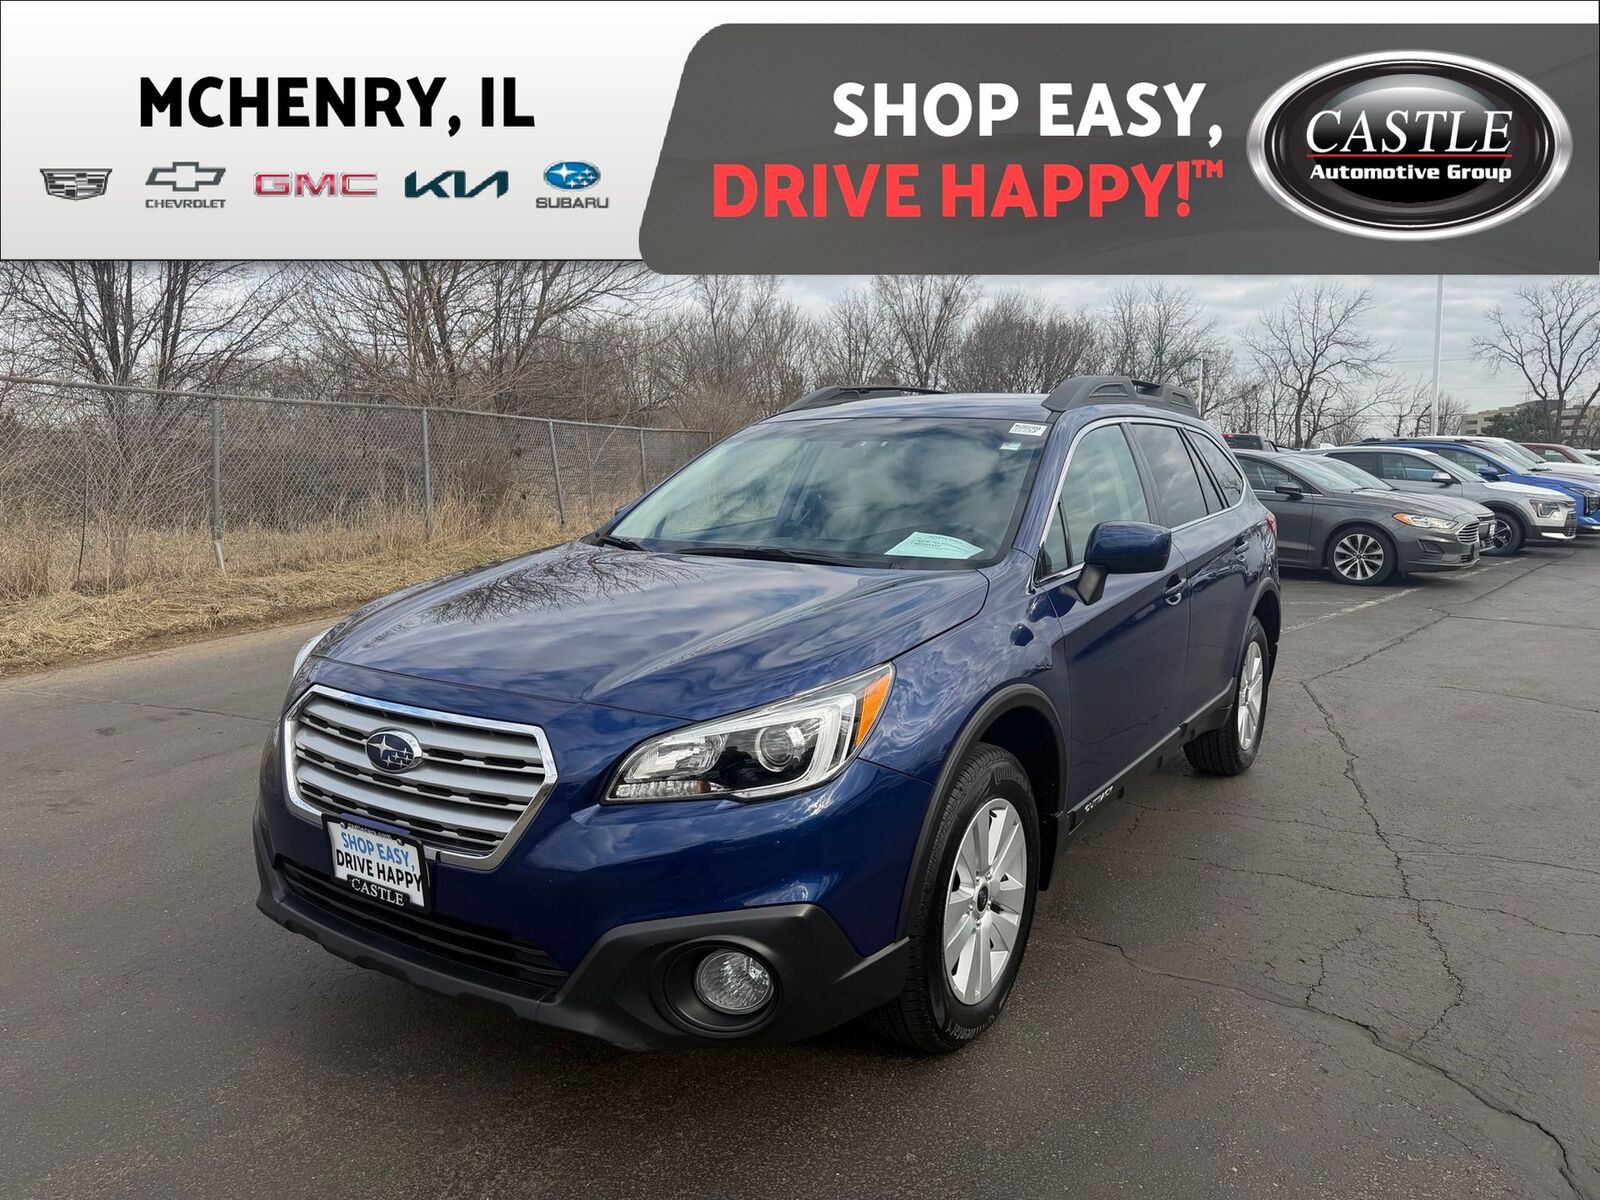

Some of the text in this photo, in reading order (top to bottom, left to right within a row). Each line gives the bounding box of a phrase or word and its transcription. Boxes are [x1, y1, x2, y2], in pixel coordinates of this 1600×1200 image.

[341, 832, 374, 855] SHOP
[336, 849, 421, 892] DRIVE HAPPY
[351, 878, 405, 907] CASTLE
